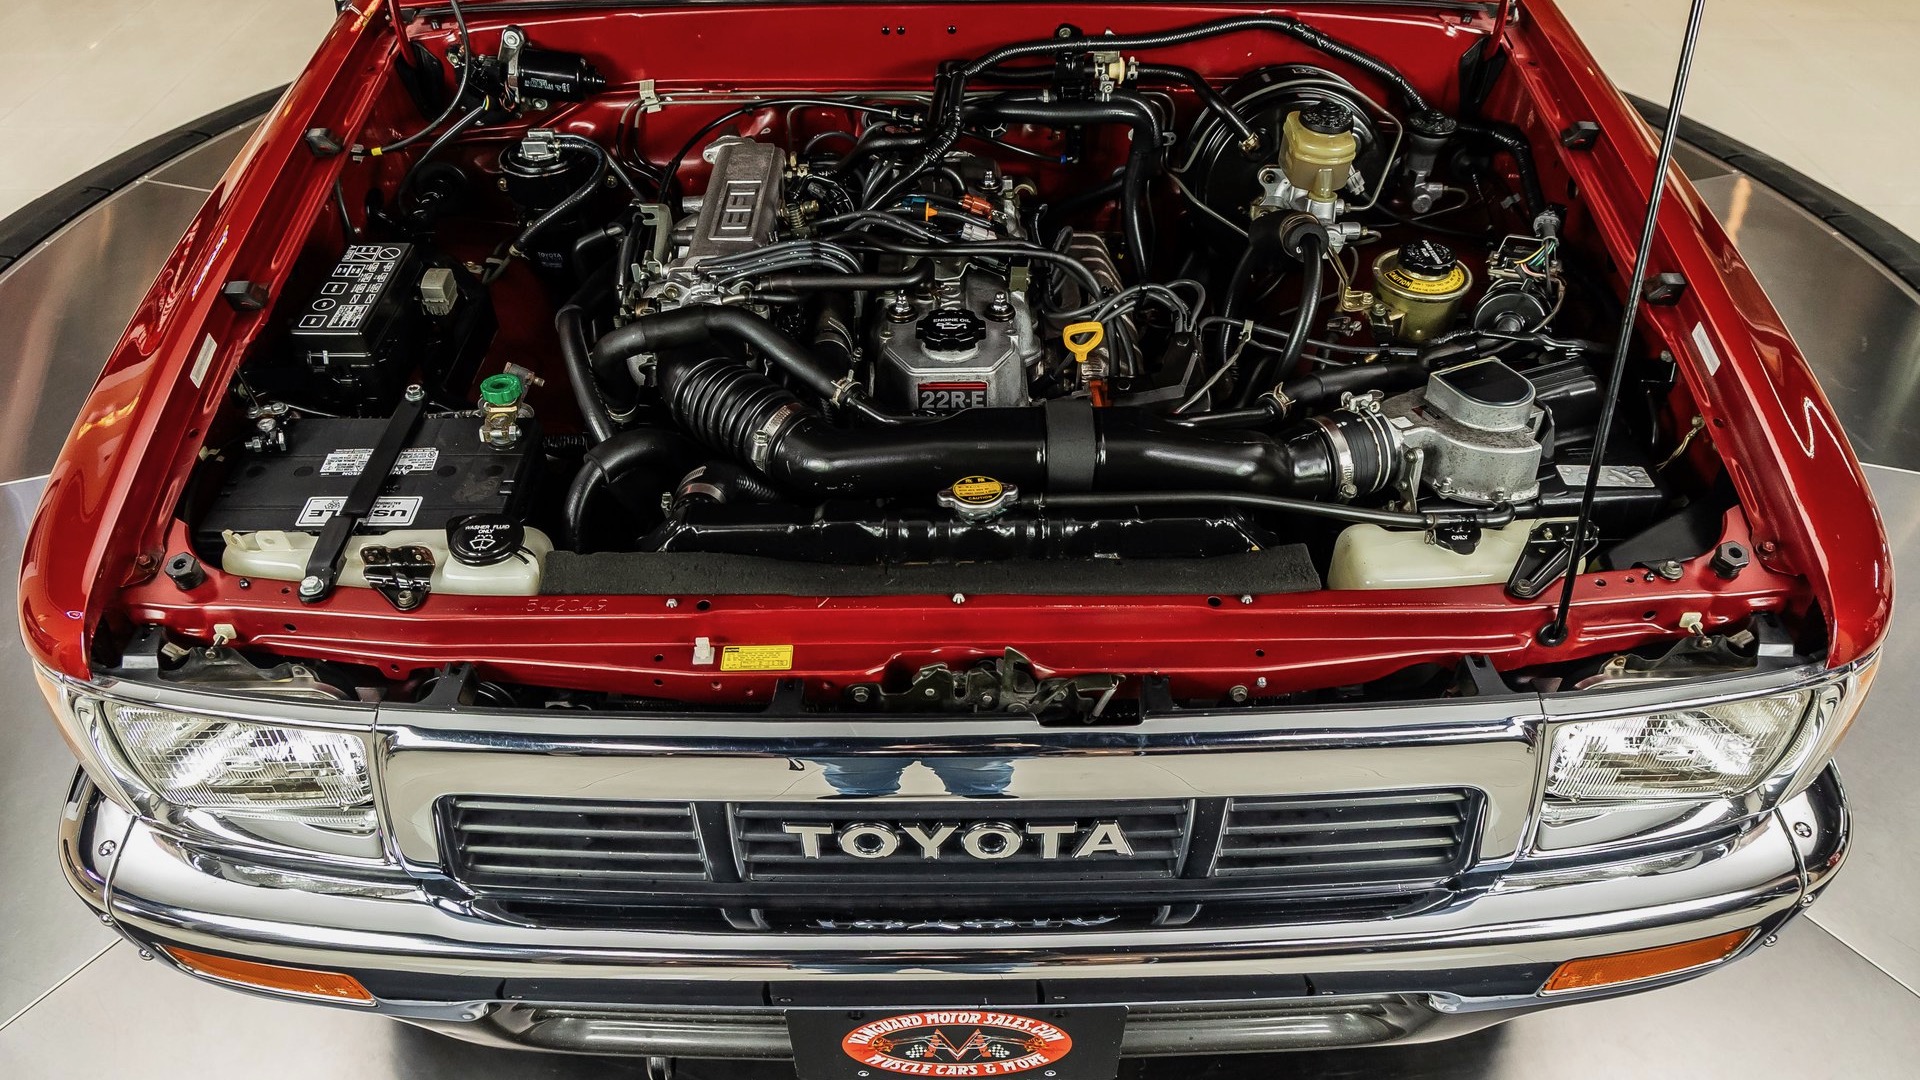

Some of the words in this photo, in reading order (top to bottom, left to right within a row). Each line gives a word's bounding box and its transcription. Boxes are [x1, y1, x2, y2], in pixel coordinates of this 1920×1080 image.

[721, 189, 755, 230] EFI
[921, 391, 985, 409] 22R-E
[782, 820, 1135, 859] TOYOTA
[848, 1015, 923, 1045] VANGUARD
[926, 1012, 980, 1024] MOTOR
[983, 1012, 1065, 1043] SALES.COM
[864, 1054, 931, 1075] MUSCLE
[935, 1064, 978, 1076] CARS
[985, 1063, 997, 1074] &
[1003, 1053, 1050, 1073] MORE
